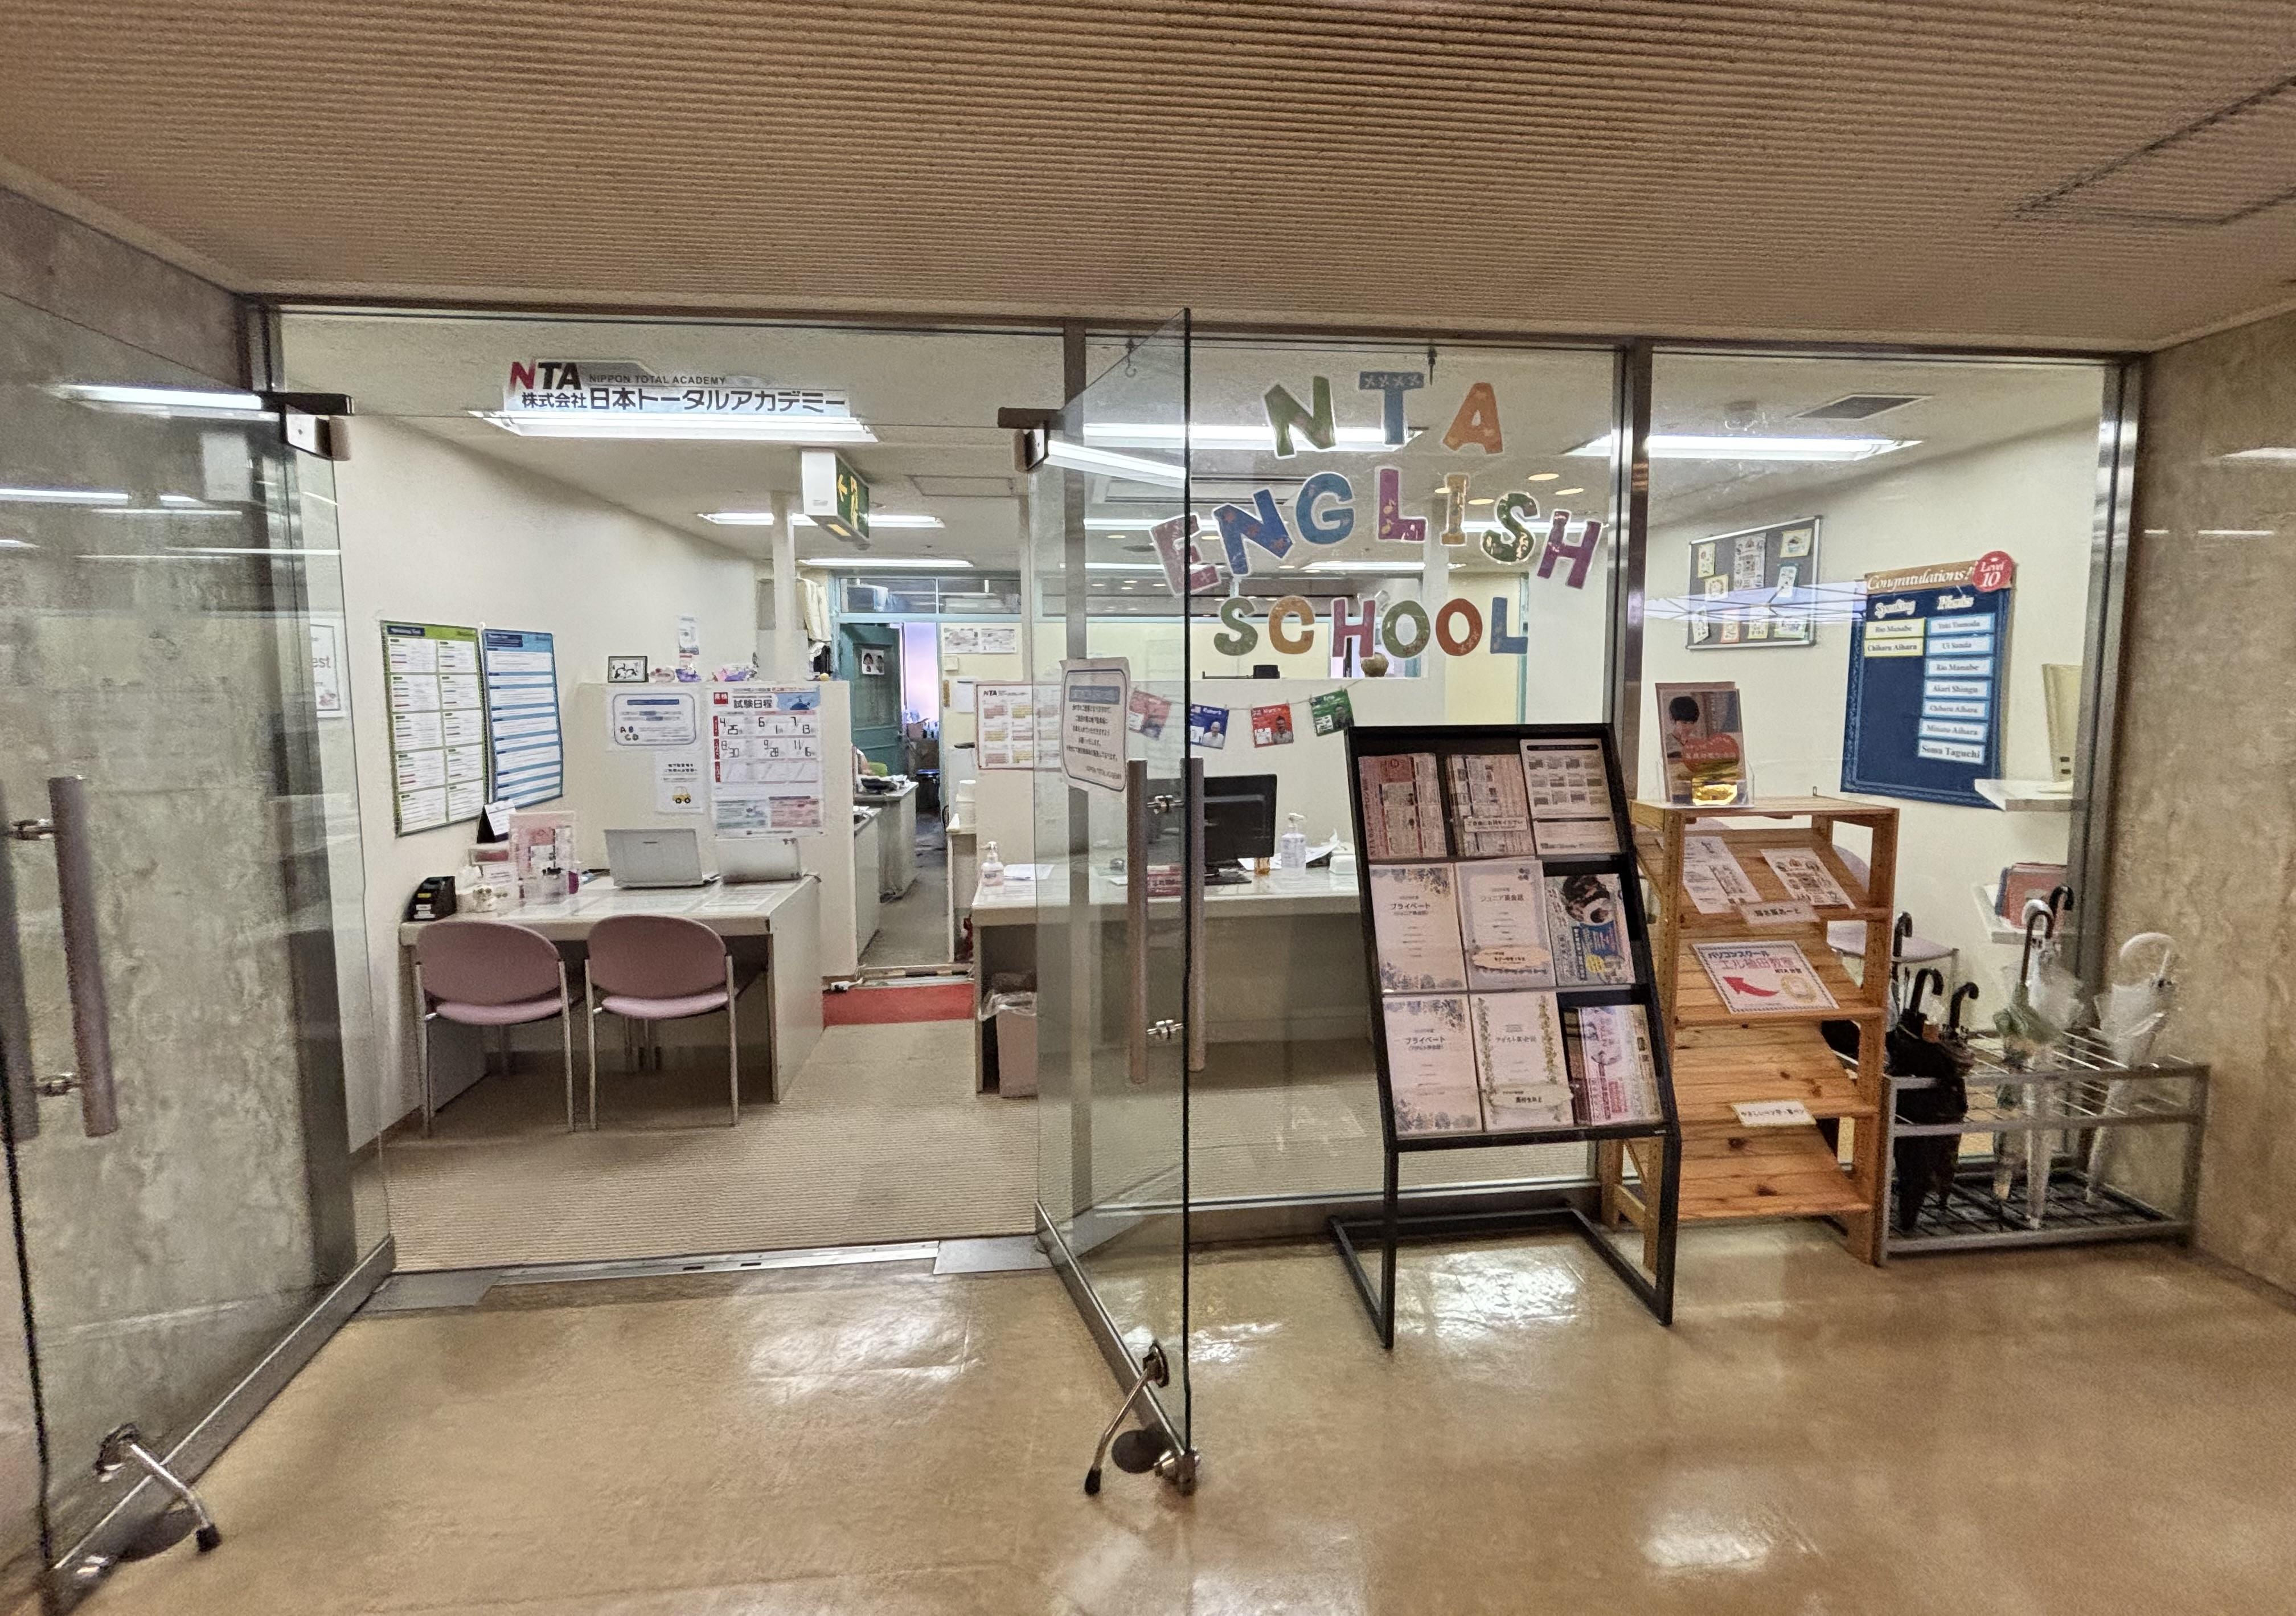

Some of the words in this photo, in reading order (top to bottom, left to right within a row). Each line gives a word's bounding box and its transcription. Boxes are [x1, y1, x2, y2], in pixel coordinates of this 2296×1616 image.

[510, 361, 581, 390] NTA
[589, 374, 630, 383] NIPPON
[673, 376, 725, 384] ACADEMY
[522, 387, 845, 412] 株式会社日本トータルアカデミー
[1263, 371, 1503, 459] NTA
[1150, 465, 1602, 596] ENGLISH
[1982, 571, 2001, 587] 10
[1213, 596, 1528, 658] SCHOOL
[733, 699, 772, 709] 試験日程
[1945, 747, 1981, 758] Taguchi
[1708, 950, 1769, 959] パソコンスクール
